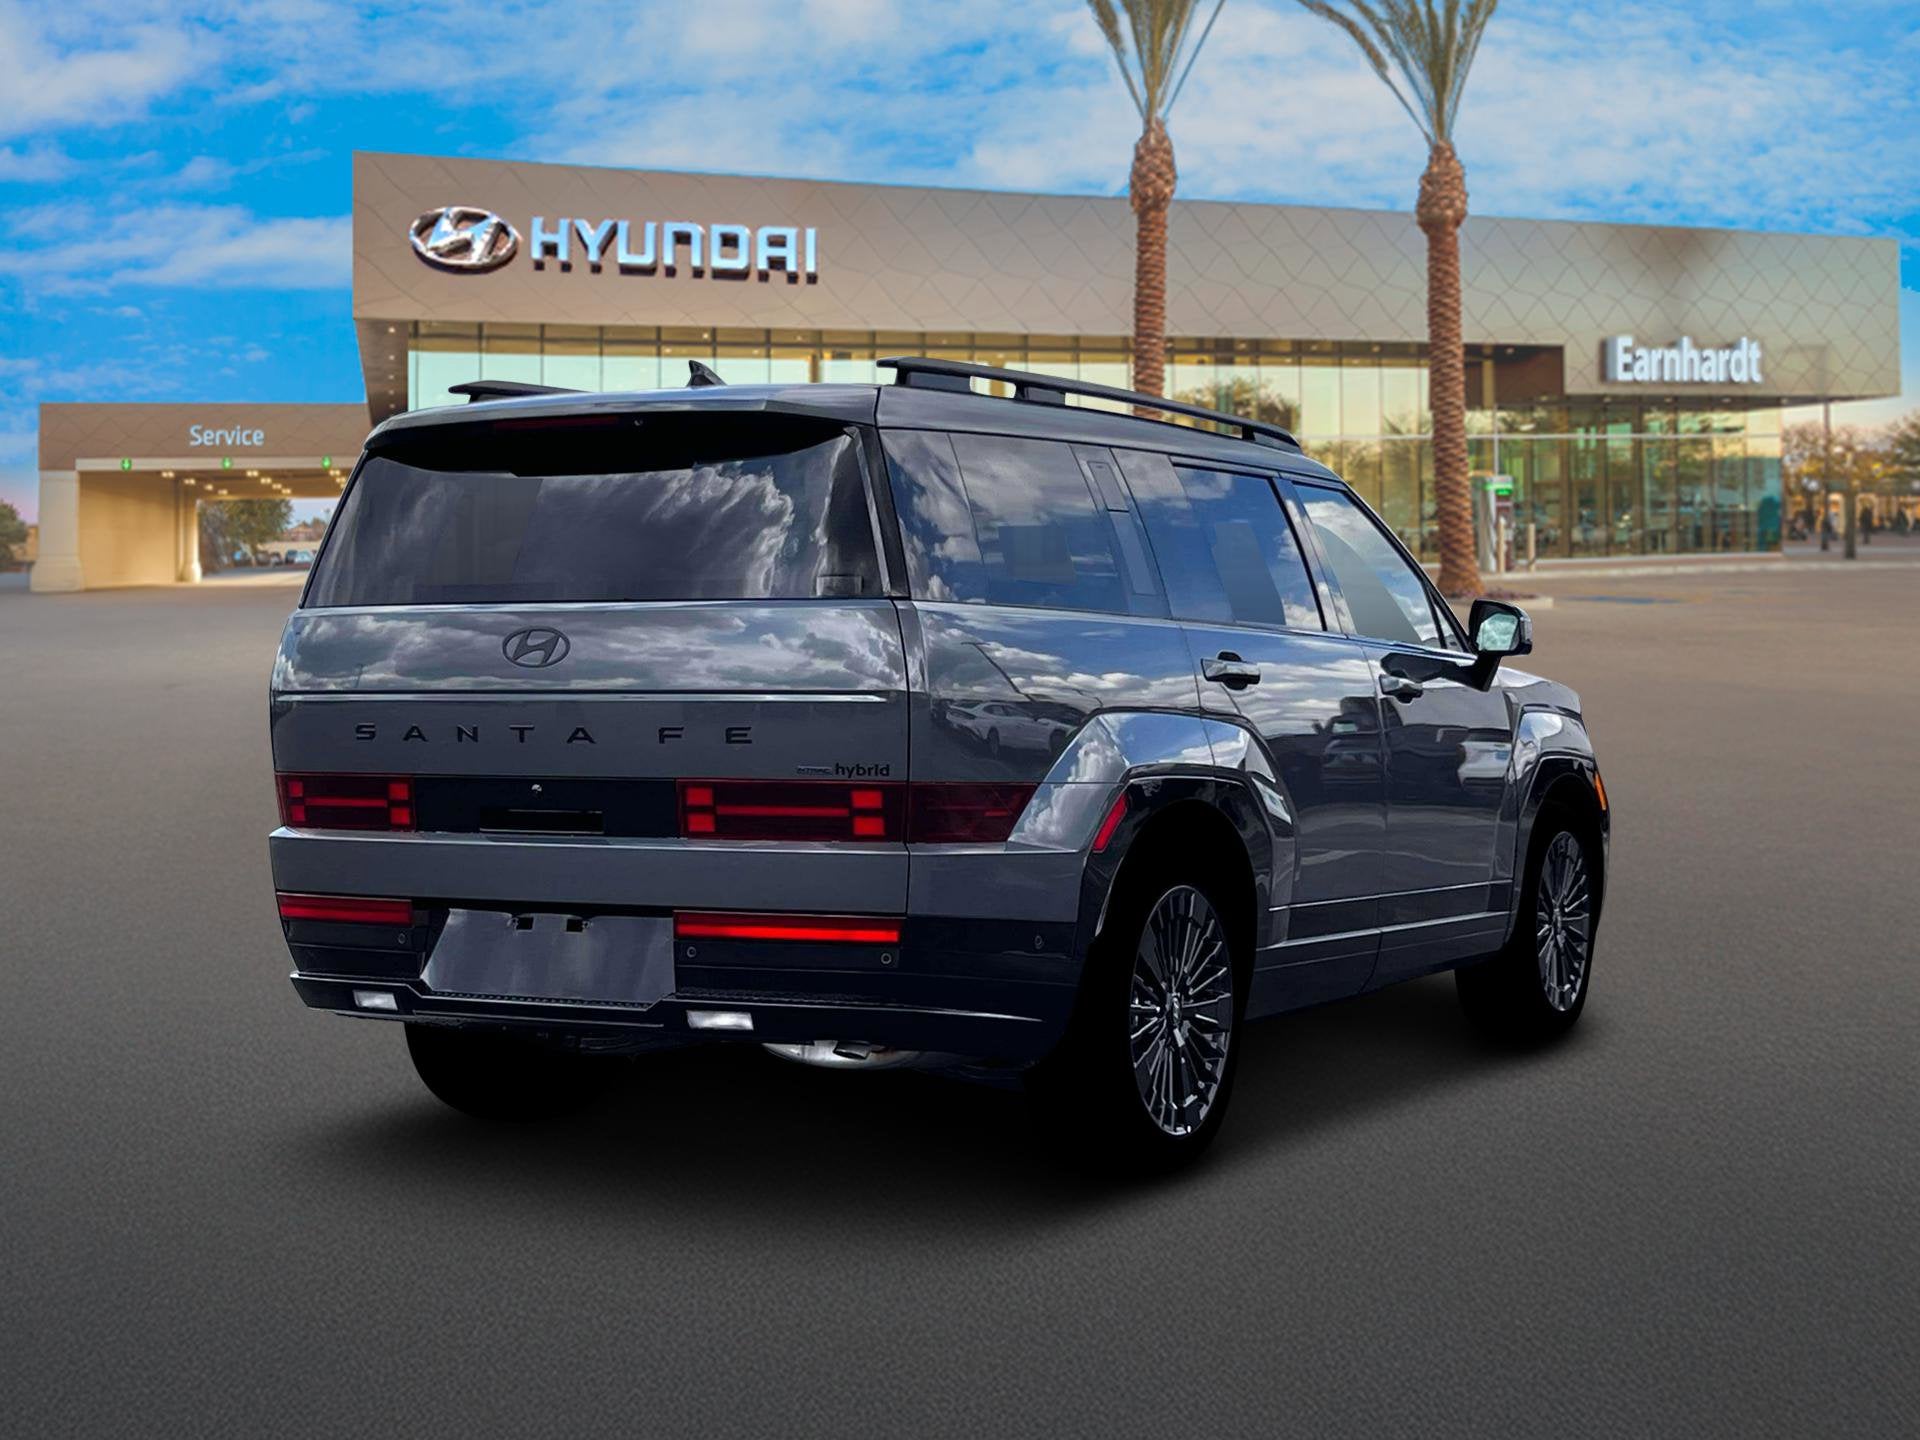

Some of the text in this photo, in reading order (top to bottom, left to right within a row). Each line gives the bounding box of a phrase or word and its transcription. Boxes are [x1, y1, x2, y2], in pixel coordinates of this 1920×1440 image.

[530, 217, 818, 283] HYUNDAI
[1606, 335, 1763, 383] Earnhardt
[189, 424, 265, 446] Service
[355, 723, 753, 744] SANTA FE
[834, 762, 890, 778] hybrid
